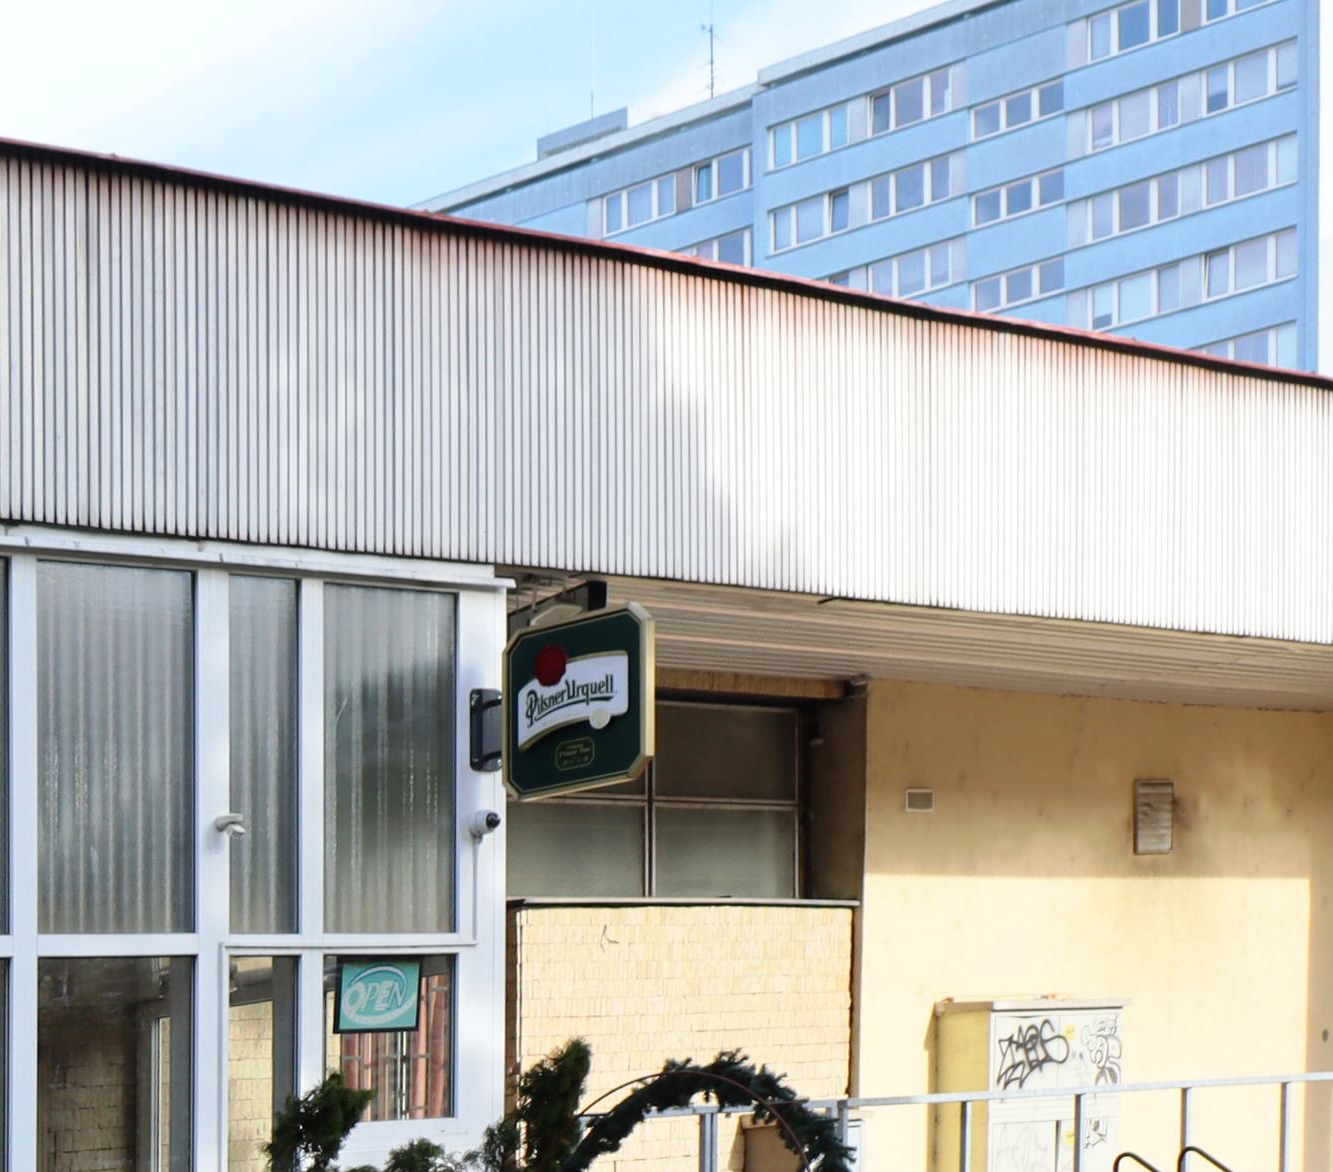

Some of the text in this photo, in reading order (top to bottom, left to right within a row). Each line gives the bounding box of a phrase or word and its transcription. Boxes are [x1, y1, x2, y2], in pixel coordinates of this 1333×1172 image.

[525, 673, 614, 728] Pilsner Urquell
[343, 980, 406, 1013] OPEN
